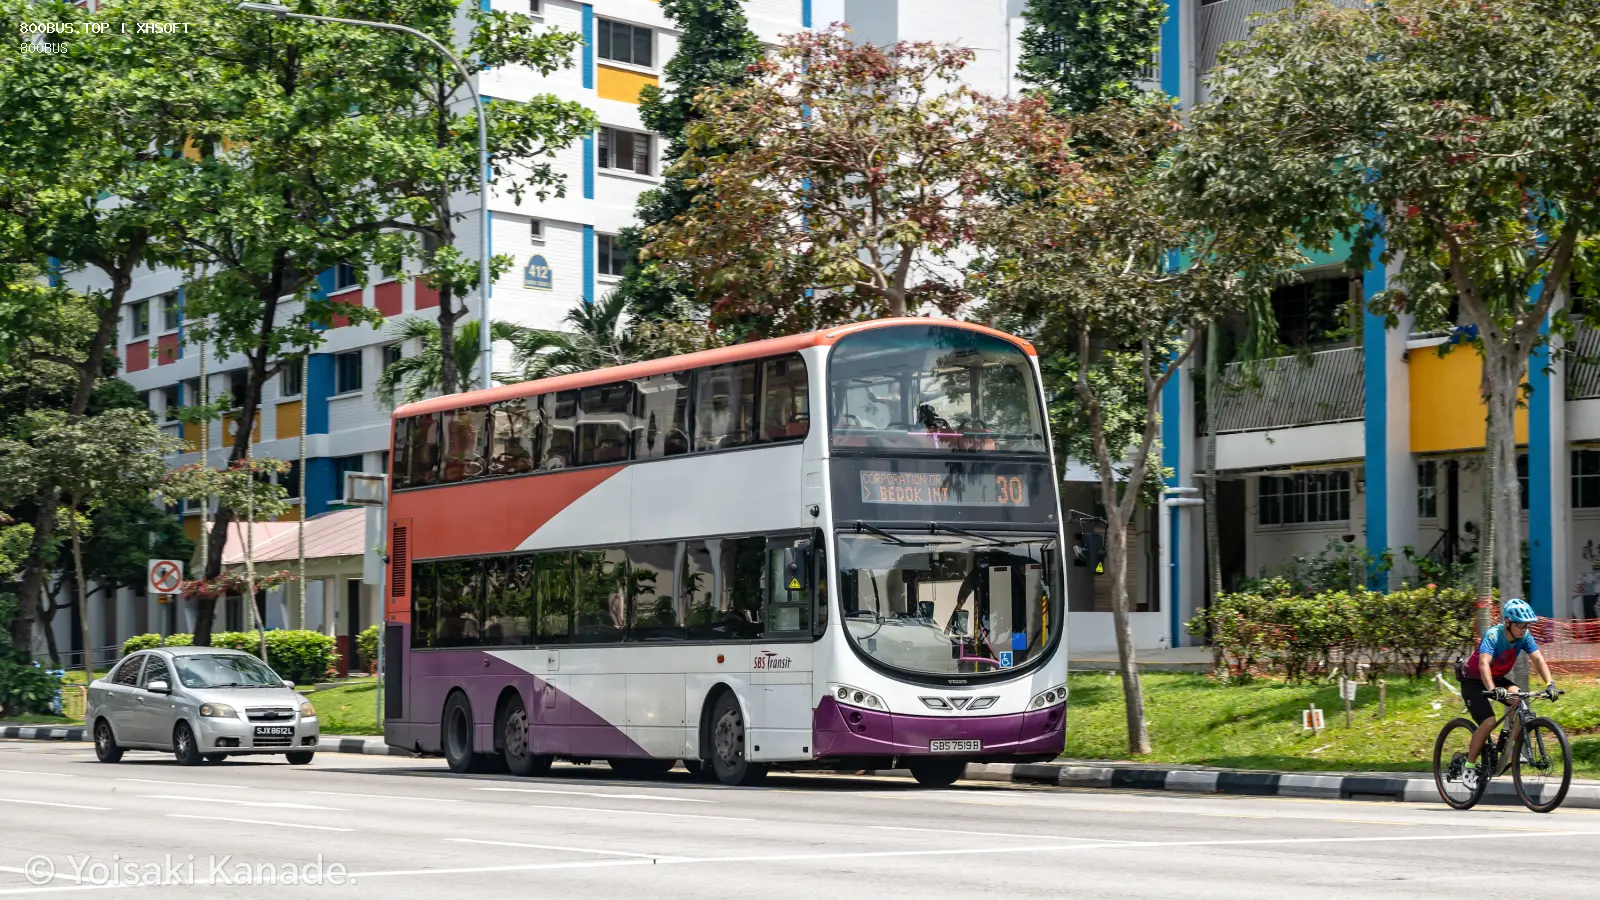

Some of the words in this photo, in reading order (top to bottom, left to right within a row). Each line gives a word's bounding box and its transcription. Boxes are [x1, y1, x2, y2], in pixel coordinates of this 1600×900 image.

[528, 264, 549, 278] 412
[862, 473, 927, 485] CORPORATION
[880, 486, 921, 503] BEDOK
[927, 487, 949, 503] INT
[996, 475, 1024, 504] 30
[753, 656, 766, 669] SBS
[764, 652, 792, 671] Transit
